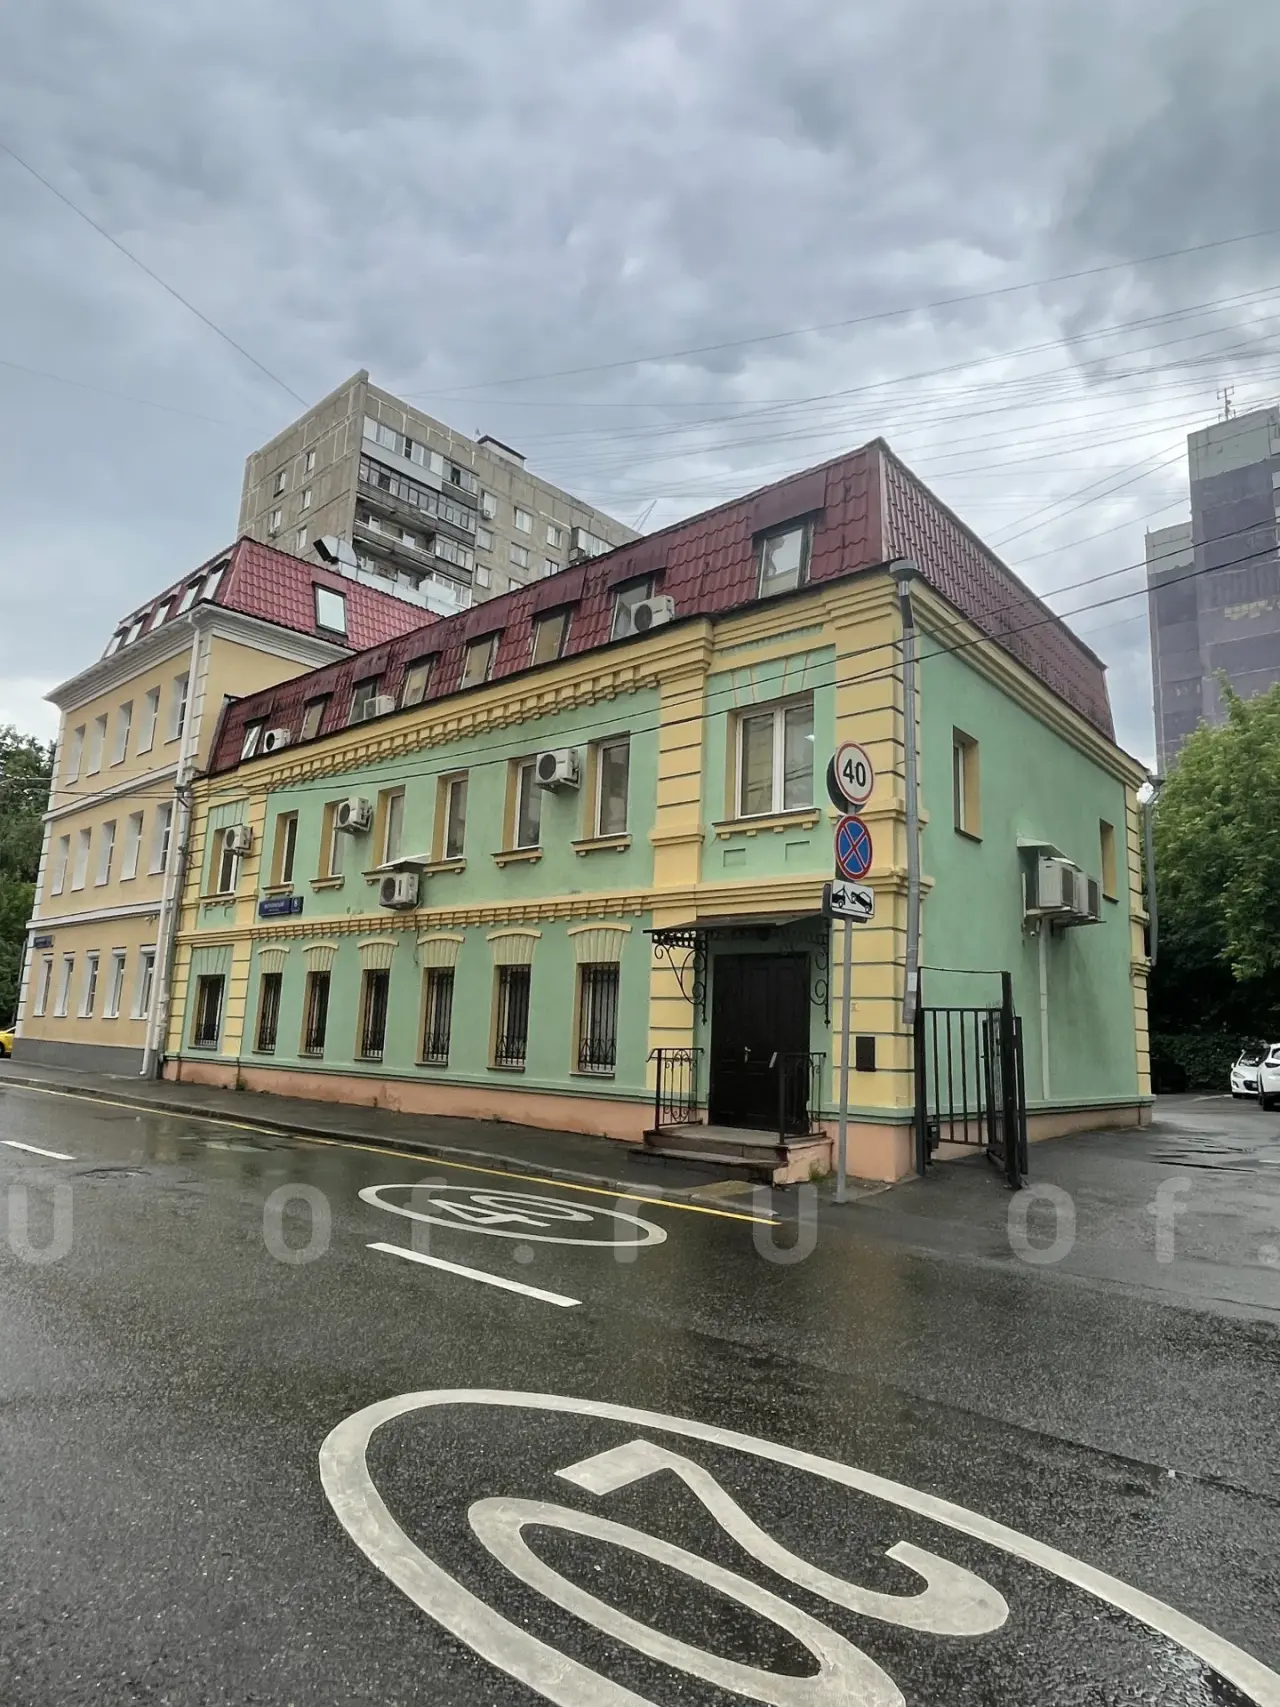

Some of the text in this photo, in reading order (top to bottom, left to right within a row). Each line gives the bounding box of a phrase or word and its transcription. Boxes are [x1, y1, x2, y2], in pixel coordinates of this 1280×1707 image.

[843, 758, 866, 787] 40
[428, 1195, 594, 1227] 40
[467, 1439, 1010, 1707] 20
